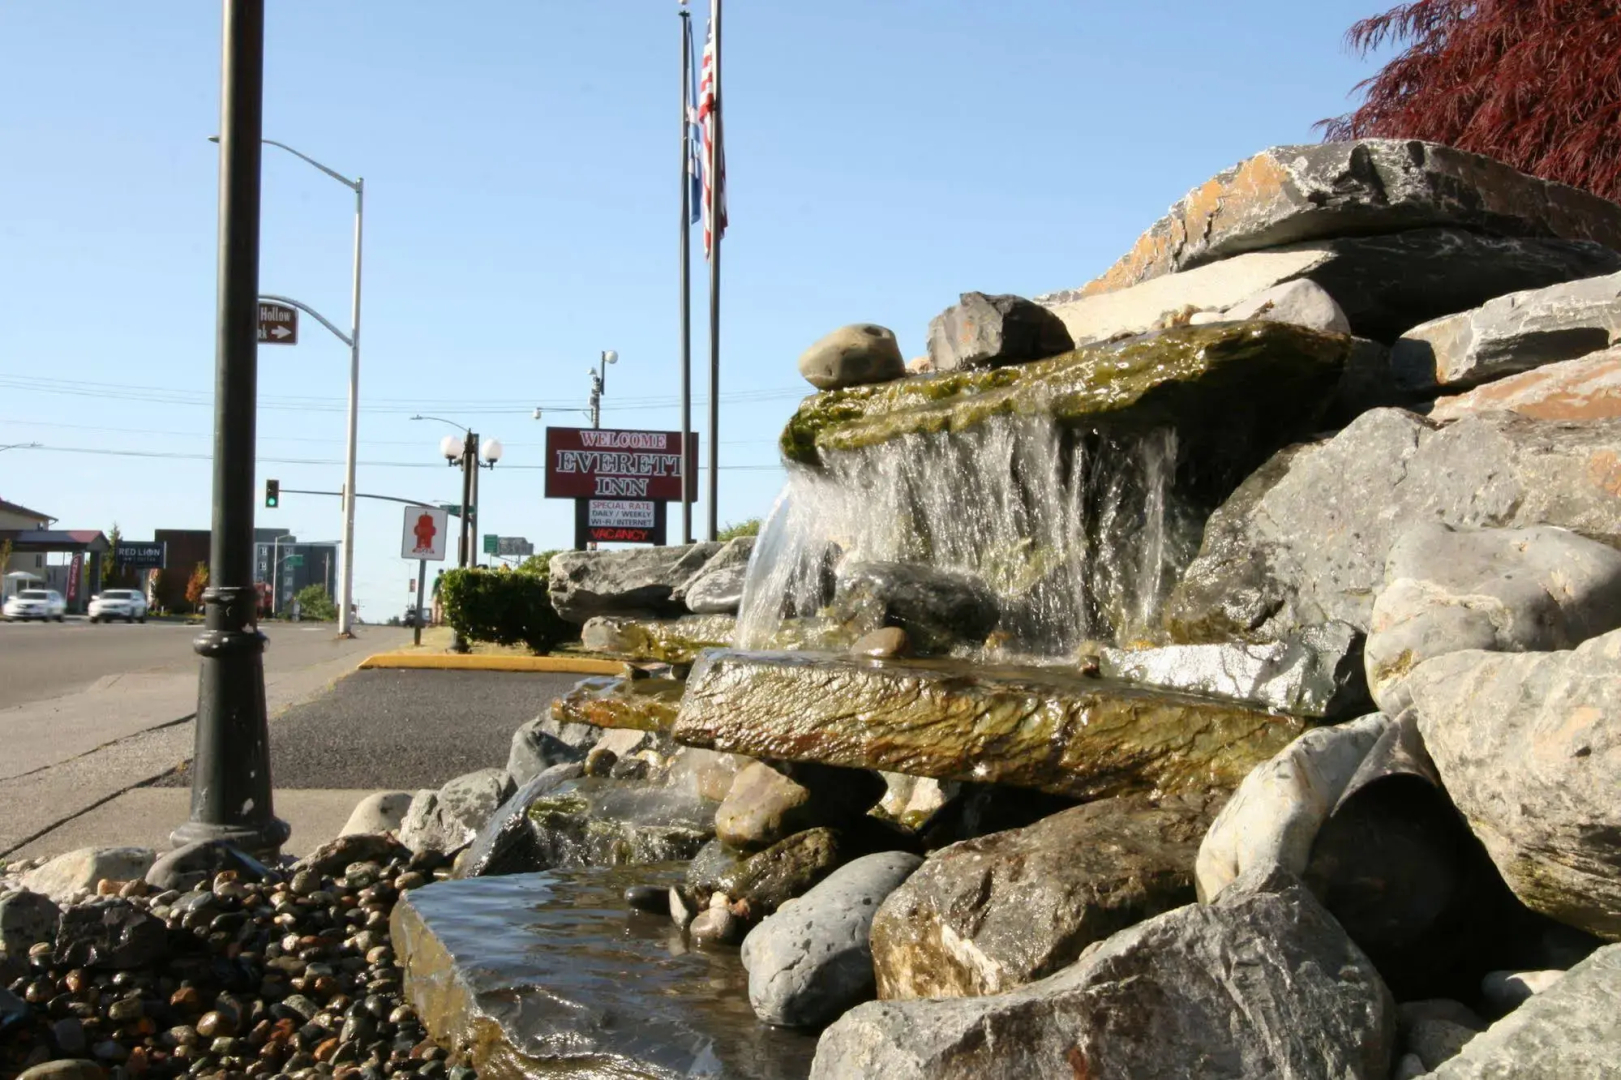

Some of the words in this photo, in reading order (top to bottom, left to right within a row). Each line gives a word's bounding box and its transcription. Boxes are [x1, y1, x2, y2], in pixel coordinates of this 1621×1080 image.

[260, 306, 291, 322] Hollow
[580, 430, 667, 449] WELCOME
[595, 476, 649, 496] INN
[592, 501, 625, 510] SPECIAL
[629, 502, 651, 511] RATE
[621, 510, 652, 518] WEEKLY
[591, 528, 648, 540] VACANCY
[118, 547, 136, 556] RED
[138, 547, 160, 556] LION
